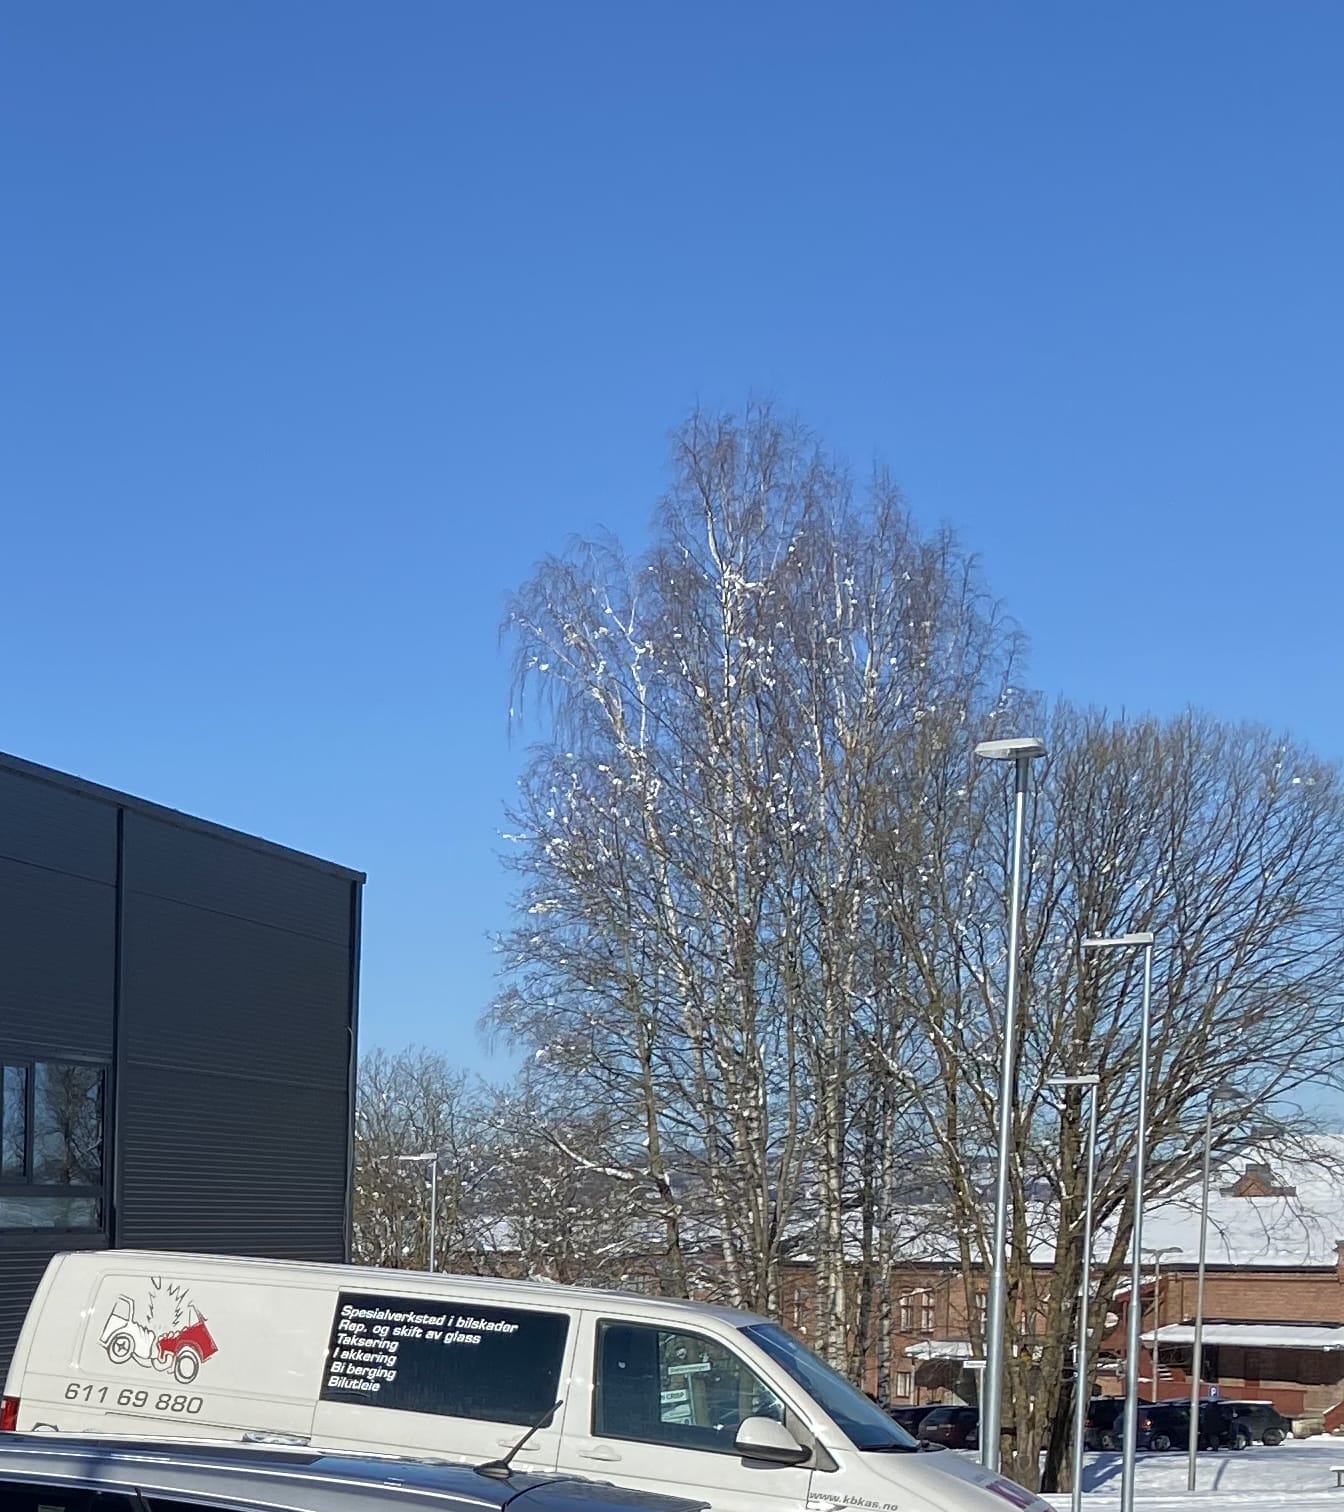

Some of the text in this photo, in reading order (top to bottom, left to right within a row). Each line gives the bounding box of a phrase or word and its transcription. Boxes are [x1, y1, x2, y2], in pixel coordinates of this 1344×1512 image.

[341, 1305, 518, 1333] Spesialverksted i bilskader
[337, 1333, 399, 1352] Taksering
[339, 1319, 481, 1344] Rep. og skift av glass
[328, 1376, 380, 1391] Bilutleie
[65, 1383, 204, 1414] 611 69 880
[809, 1491, 899, 1512] www.kbkas.no
